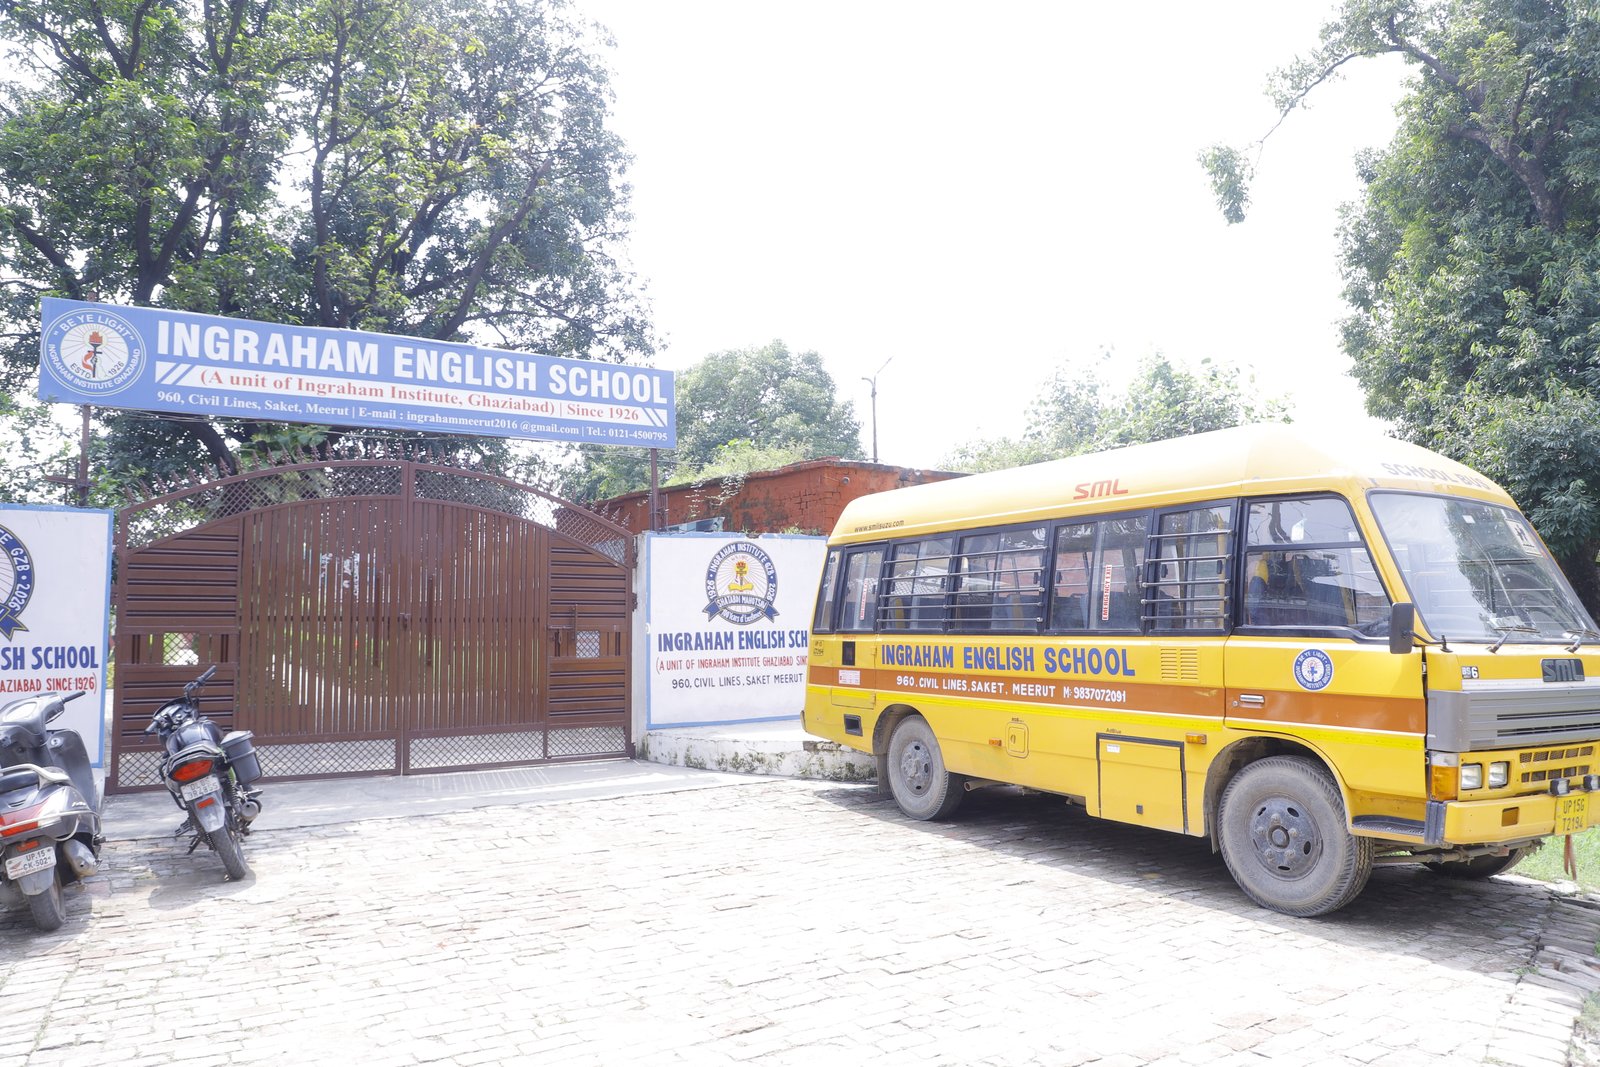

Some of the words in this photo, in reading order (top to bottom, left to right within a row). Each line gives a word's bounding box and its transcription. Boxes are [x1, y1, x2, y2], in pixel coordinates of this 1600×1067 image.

[77, 314, 94, 323] YE
[48, 343, 75, 381] INGRAHAM
[73, 377, 114, 390] INSTITUTE
[113, 348, 141, 385] GHAZIABAD
[108, 361, 125, 376] 1926
[157, 320, 378, 375] INGRAHAM
[394, 347, 537, 391] ENGLISH
[549, 364, 668, 404] SCHOOL
[201, 369, 223, 386] (A
[230, 374, 267, 388] unit
[273, 373, 292, 390] of
[297, 378, 384, 398] Ingraham
[390, 386, 463, 406] Institute,
[468, 393, 555, 415] Ghaziabad)
[566, 404, 604, 418] Since
[609, 407, 639, 421] 1926
[157, 391, 185, 405] 960,
[188, 393, 220, 407] Civil
[223, 396, 262, 411] Lines,
[264, 399, 302, 414] Saket,
[305, 403, 349, 416] Meerut
[359, 407, 397, 420] E-mail
[608, 428, 668, 441] 0121-4500795
[1381, 462, 1458, 483] SCHOOL
[1073, 478, 1129, 500] SML
[10, 546, 30, 572] GZB
[709, 543, 736, 572] INGRAHAM
[737, 543, 768, 562] INSTITUTE
[8, 583, 31, 611] 2026
[707, 580, 717, 600] 1926
[766, 583, 776, 602] 2026
[1102, 580, 1111, 620] EMERGENCY
[658, 631, 734, 652] INGRAHAM
[738, 630, 785, 650] ENGLISH
[788, 630, 808, 648] SCH
[31, 646, 99, 671] SCHOOL
[666, 659, 683, 671] UNIT
[685, 659, 695, 669] OF
[697, 657, 730, 669] INGRAHAM
[732, 656, 761, 668] INSTITUTE
[762, 655, 793, 667] GHAZIABAD
[796, 655, 808, 666] SINC
[881, 644, 954, 668] INGRAHAM
[963, 646, 1035, 672] ENGLISH
[1044, 647, 1136, 676] SCHOOL
[694, 678, 715, 688] CIVIL
[746, 675, 771, 686] SAKET
[774, 673, 803, 684] MEERUT
[1541, 659, 1585, 682] SML
[46, 677, 73, 691] SINCE
[1012, 683, 1056, 697] MEERUT
[1073, 687, 1126, 702] 9837072091
